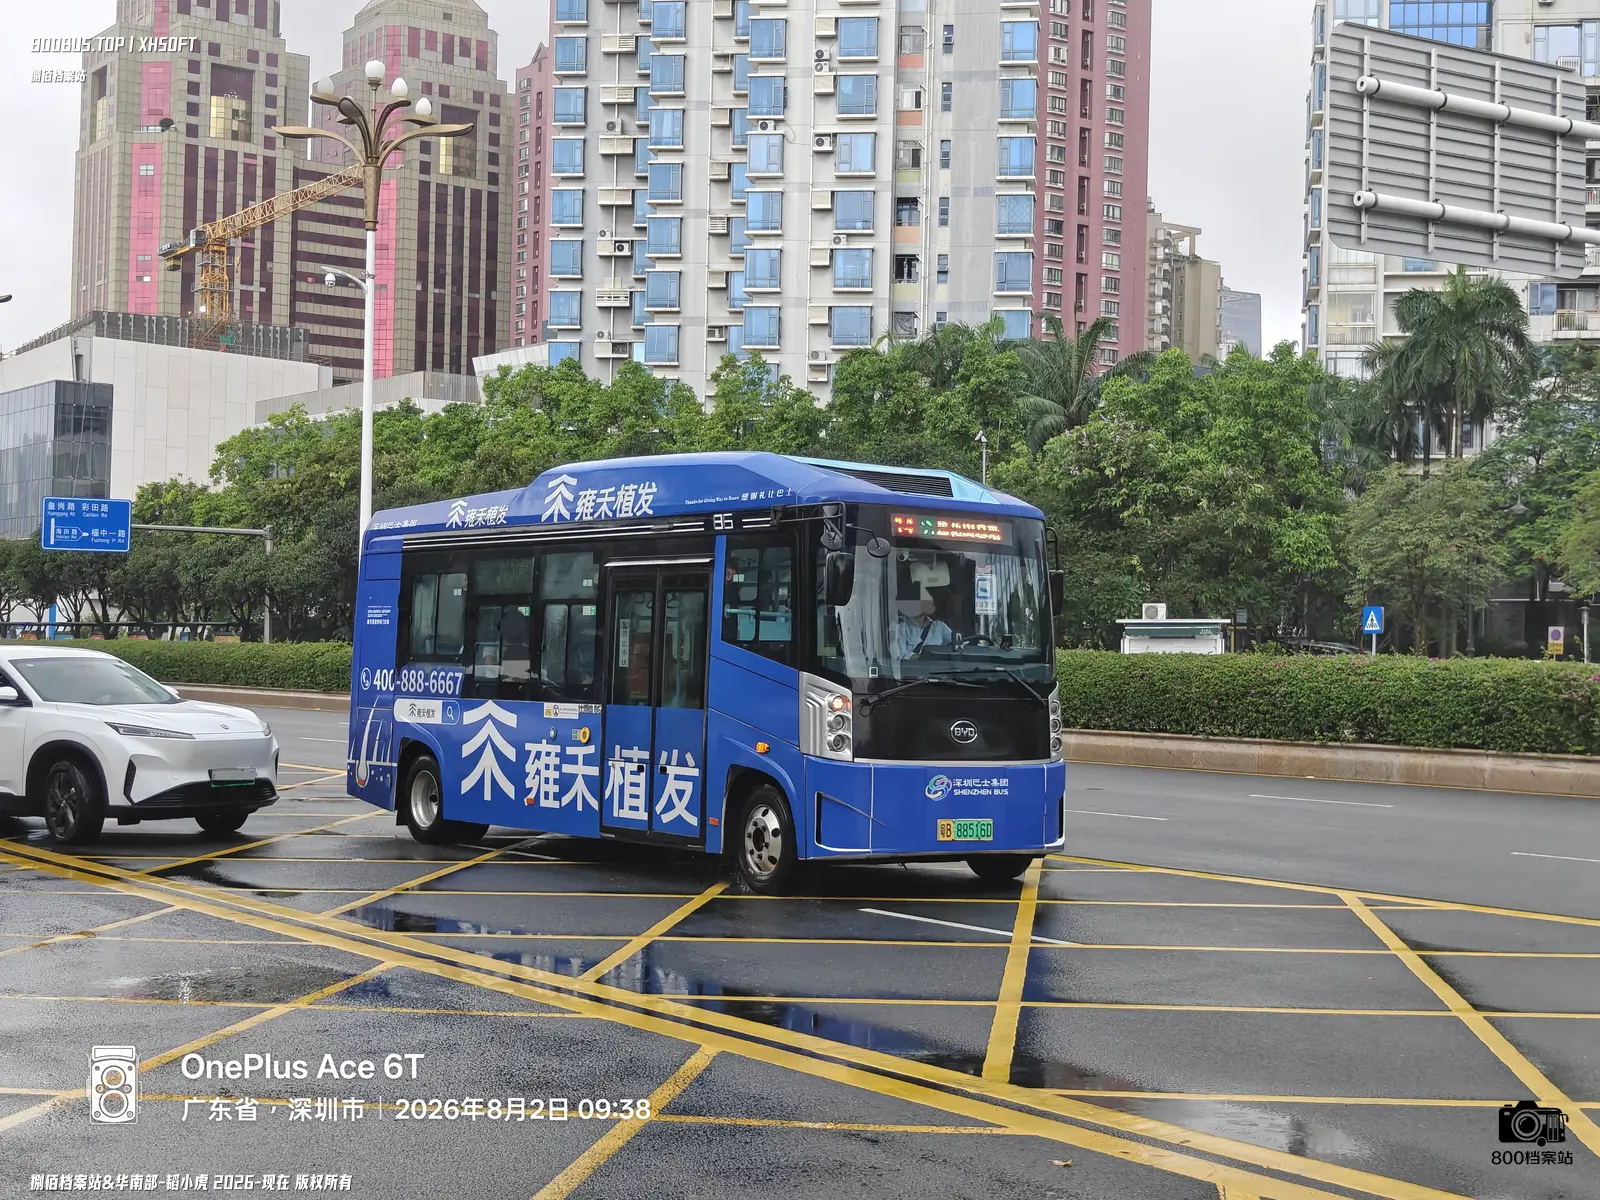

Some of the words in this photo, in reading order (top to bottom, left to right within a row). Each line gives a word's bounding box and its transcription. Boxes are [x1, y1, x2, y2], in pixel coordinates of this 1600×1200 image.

[575, 481, 658, 521] 雍禾植发
[741, 487, 793, 501] 感谢礼让巴士
[47, 501, 75, 511] 皇岗路
[82, 502, 108, 513] 彩田路
[464, 504, 508, 528] 雍禾植发
[91, 528, 125, 538] 福中一路
[373, 669, 462, 695] 400-888-6667
[954, 727, 975, 737] BYD
[524, 739, 700, 827] 雍禾植发
[953, 778, 1008, 787] 深圳巴士集团
